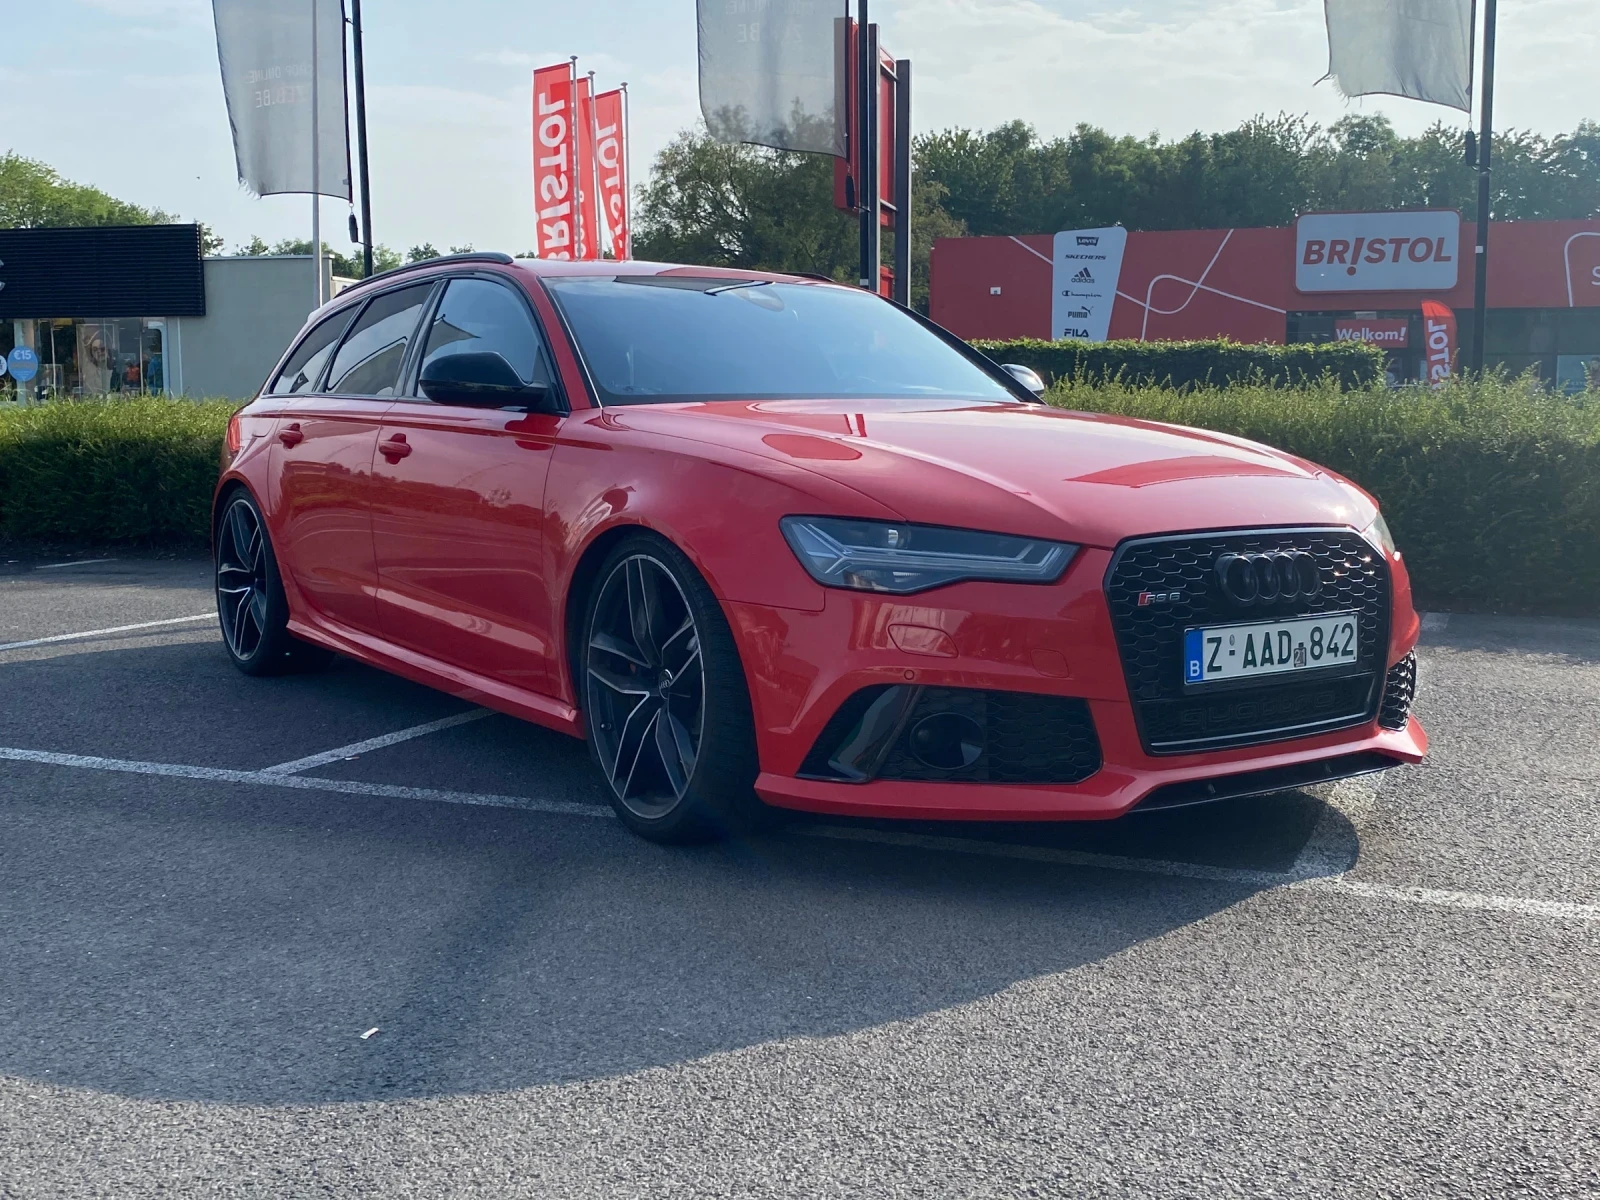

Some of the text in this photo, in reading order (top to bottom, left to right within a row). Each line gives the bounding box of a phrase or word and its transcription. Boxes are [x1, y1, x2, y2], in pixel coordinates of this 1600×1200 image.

[1062, 290, 1102, 299] Champion
[1068, 311, 1088, 319] PUMA
[1064, 328, 1089, 338] FILA
[1336, 326, 1407, 342] Welkom!
[13, 349, 32, 360] €15
[1190, 660, 1200, 677] B
